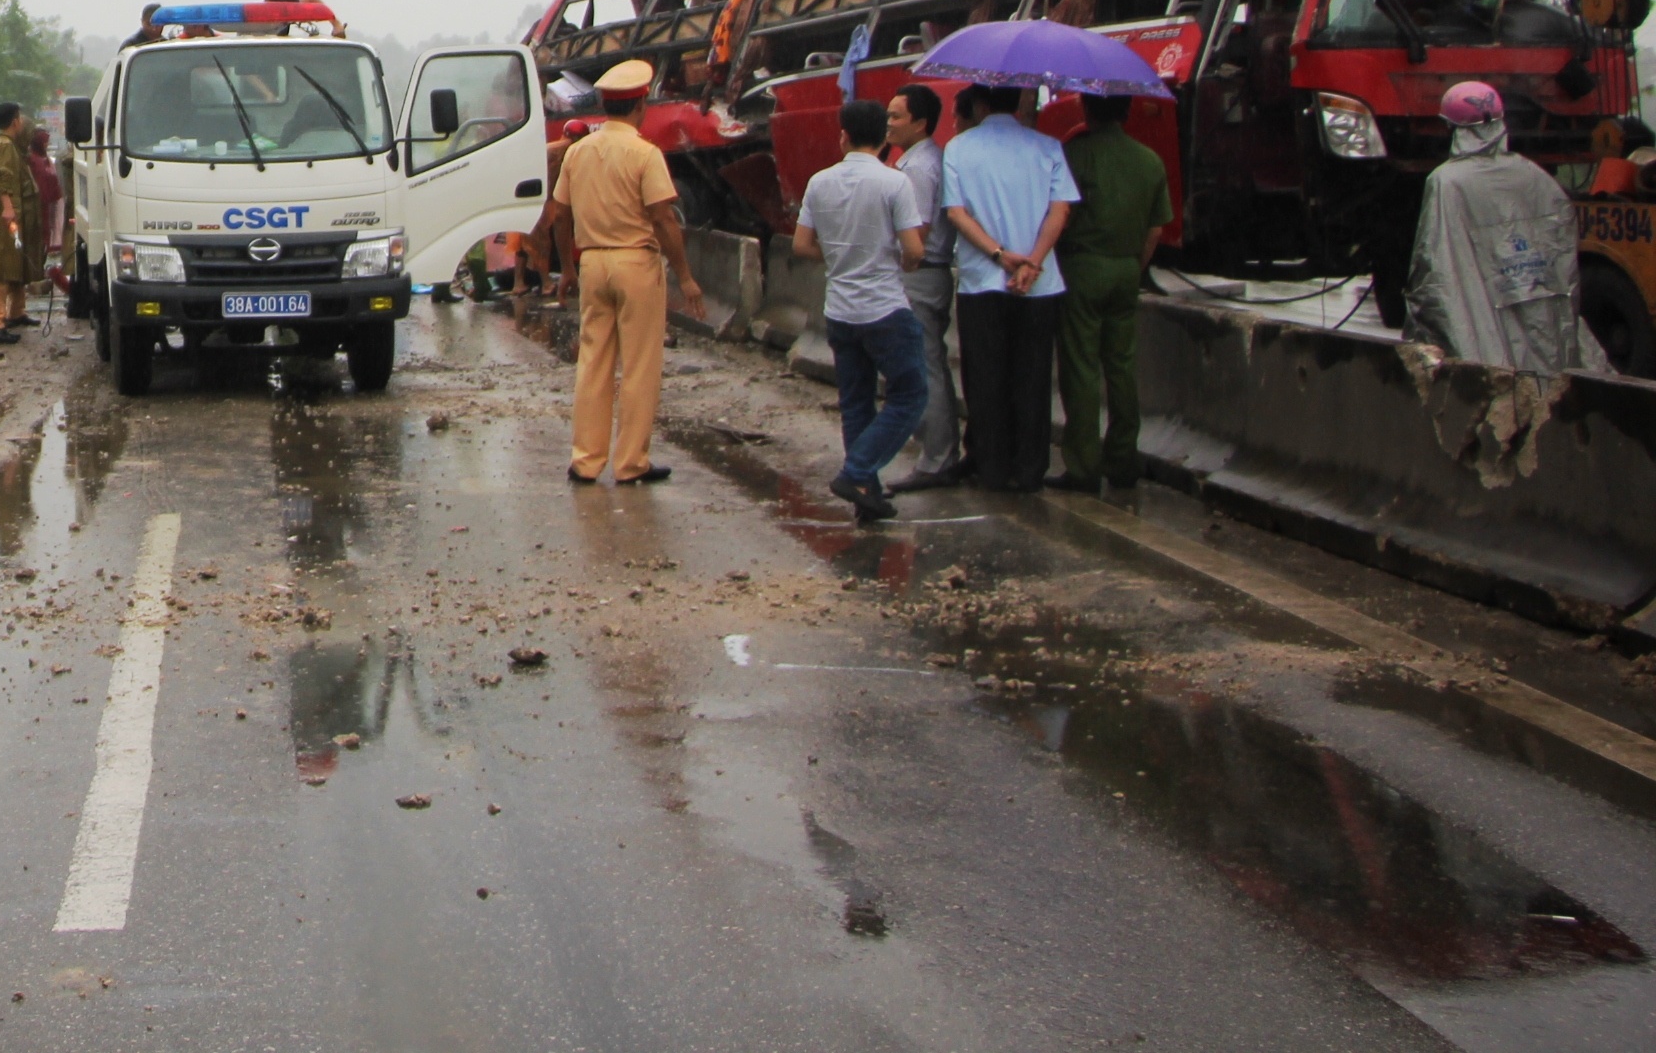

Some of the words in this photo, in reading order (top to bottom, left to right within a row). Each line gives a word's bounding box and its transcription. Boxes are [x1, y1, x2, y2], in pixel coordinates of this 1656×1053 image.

[143, 220, 193, 230] HINO
[222, 205, 310, 230] CSGT
[226, 295, 307, 314] 38A-001.64
